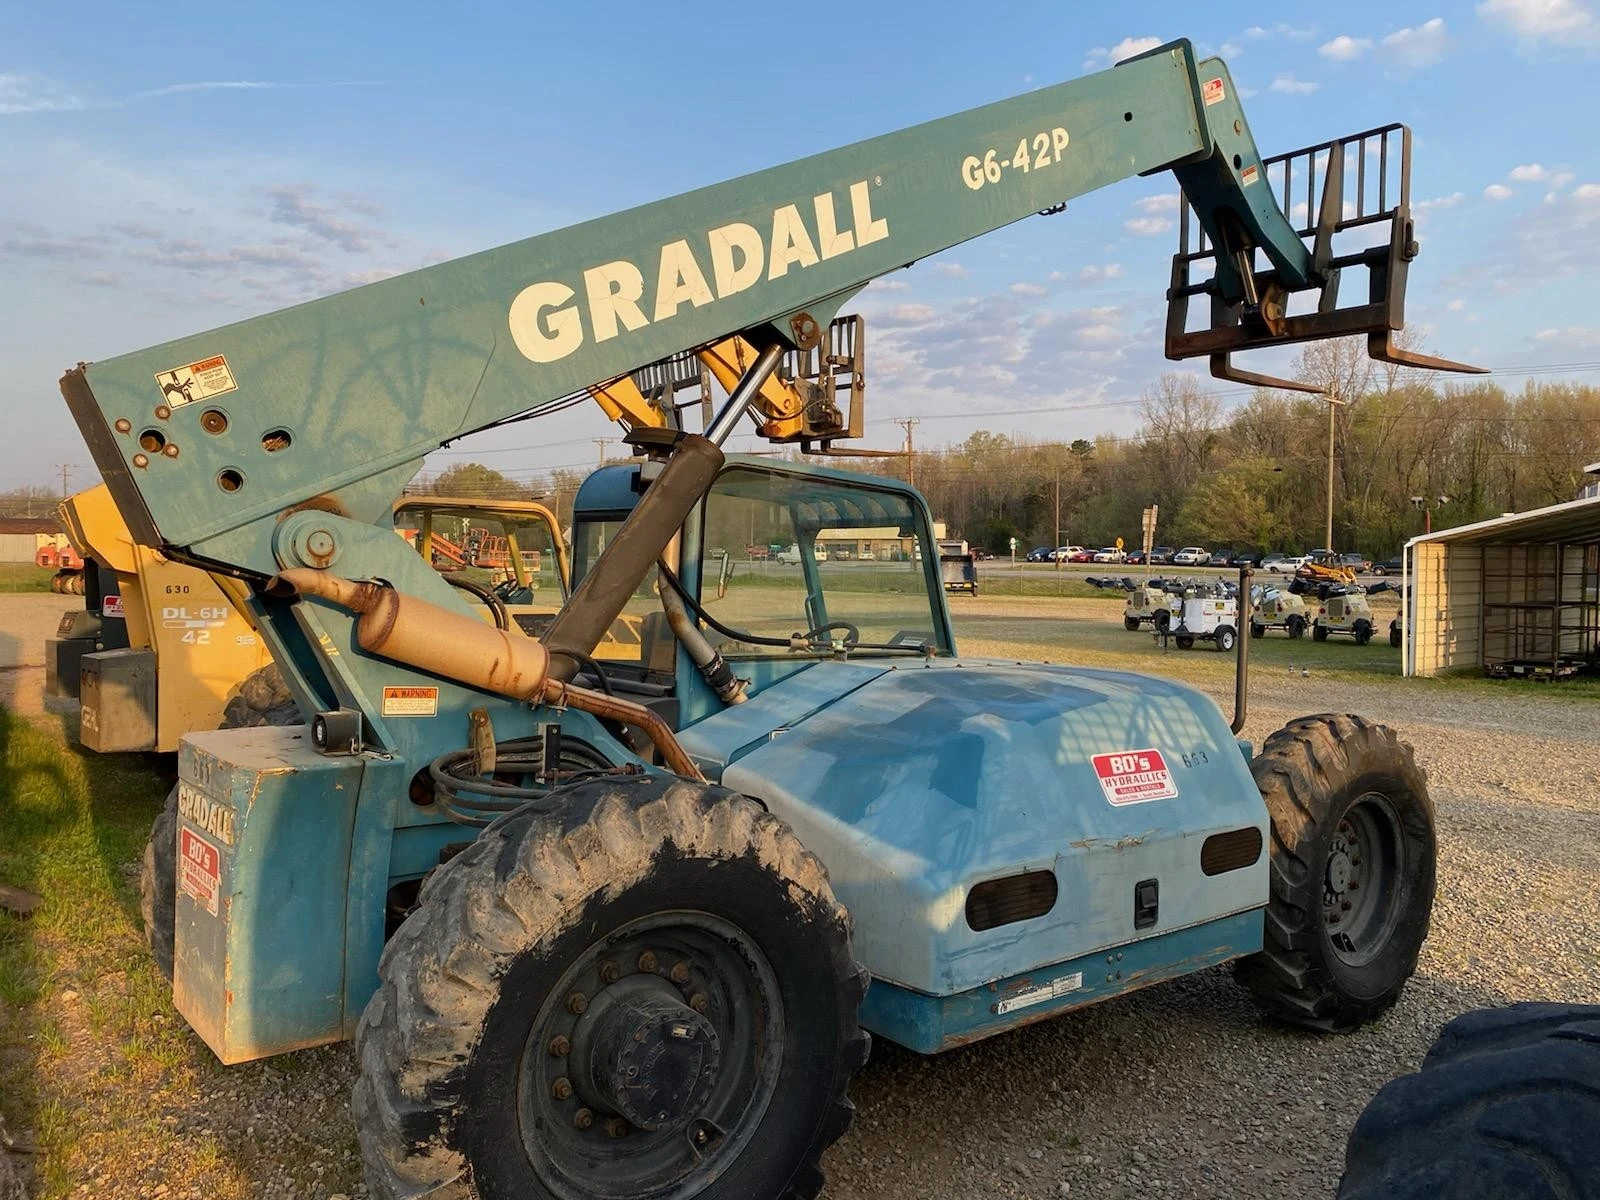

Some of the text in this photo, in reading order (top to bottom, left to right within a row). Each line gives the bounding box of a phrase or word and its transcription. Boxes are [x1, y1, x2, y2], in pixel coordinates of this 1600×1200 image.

[962, 127, 1069, 190] G6-42P
[508, 180, 889, 363] GRADALL
[166, 585, 190, 594] 630
[163, 607, 228, 619] DL-6H
[181, 630, 211, 645] 42
[400, 689, 432, 699] WARNING
[1109, 755, 1151, 775] BO's
[1105, 771, 1168, 788] HYDRAULICS
[179, 785, 234, 847] GRADALL
[189, 836, 211, 869] BO's
